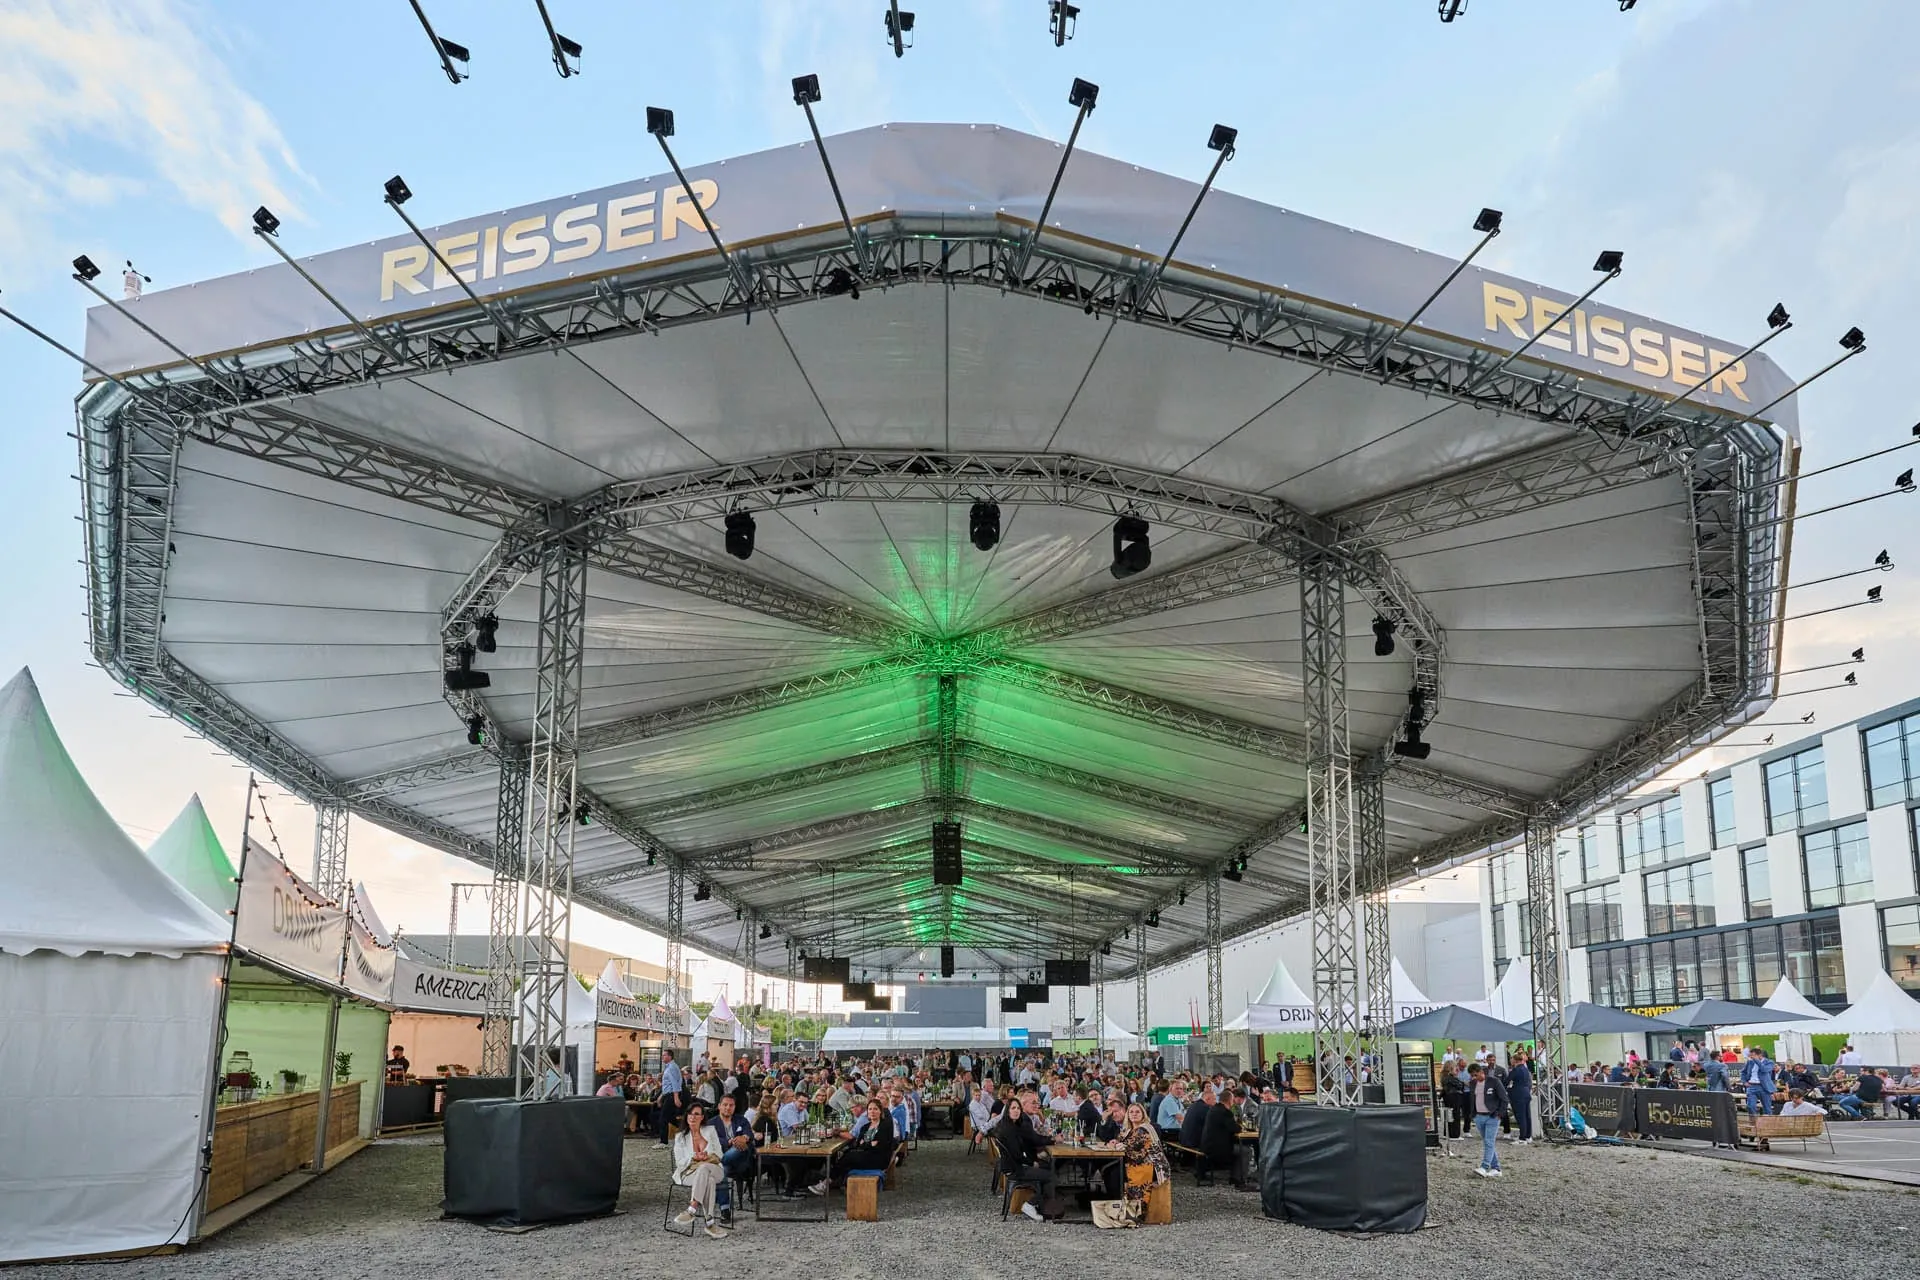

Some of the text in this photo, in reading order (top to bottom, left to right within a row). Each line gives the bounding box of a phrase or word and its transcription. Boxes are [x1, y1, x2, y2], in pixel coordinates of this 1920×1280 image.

[381, 179, 720, 302] REISSER
[1483, 281, 1750, 402] REISSER
[1280, 1008, 1337, 1021] DRINK
[1588, 1096, 1617, 1110] JAHRE
[1648, 1102, 1712, 1124] 150 JAHRE
[1672, 1117, 1713, 1128] REISSER
